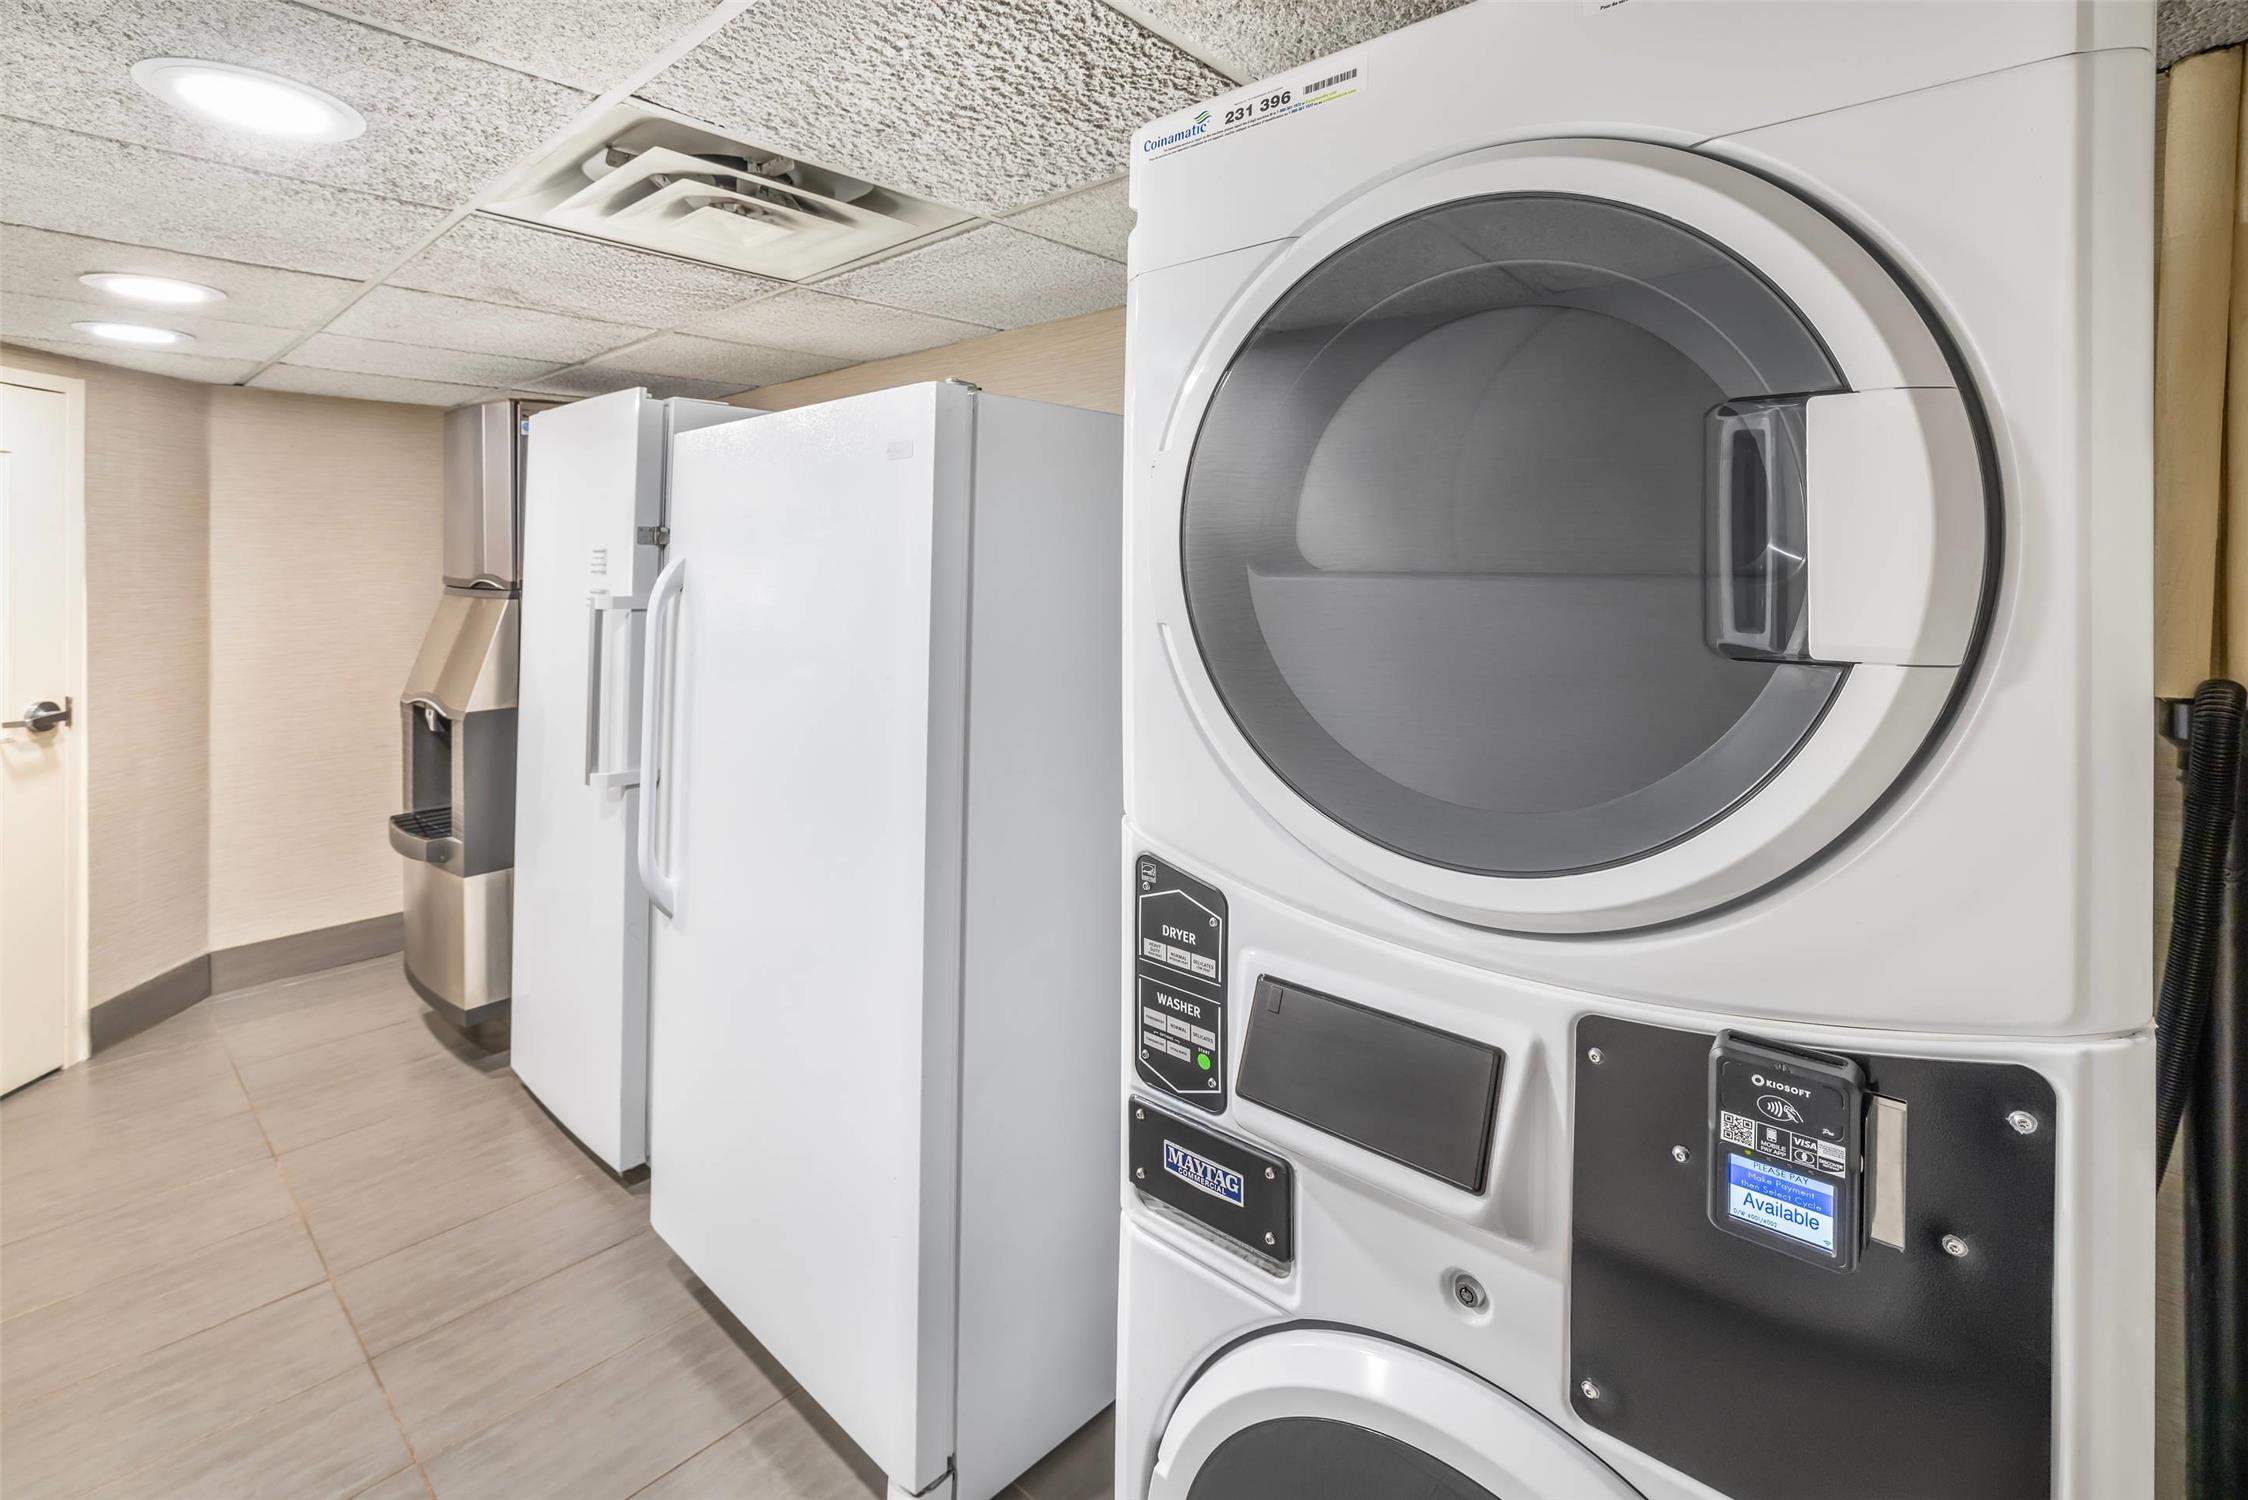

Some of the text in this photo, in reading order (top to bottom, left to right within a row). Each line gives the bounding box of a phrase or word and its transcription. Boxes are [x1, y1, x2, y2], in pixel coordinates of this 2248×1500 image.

[1225, 104, 1253, 125] 231
[1259, 91, 1291, 112] 396
[1144, 123, 1207, 152] Coinamatic
[1162, 924, 1196, 945] DRYER
[1170, 952, 1187, 960] NORMAL
[1193, 959, 1214, 970] DELICATES
[1156, 991, 1201, 1018] WASHER
[1169, 1023, 1187, 1033] NORMAL
[1192, 1031, 1214, 1044] DELICATES
[1766, 1079, 1811, 1098] KIOSOFT
[1760, 1140, 1787, 1153] MOBILE
[1760, 1146, 1787, 1157] PAY APP
[1793, 1136, 1818, 1151] VISA
[1167, 1145, 1240, 1194] MAYTAG
[1753, 1162, 1785, 1178] PLEASE
[1789, 1174, 1809, 1185] PAY
[1178, 1168, 1226, 1195] COMMERCIAL
[1748, 1171, 1815, 1199] Make Payment
[1741, 1179, 1822, 1212] then Select Cycle
[1743, 1192, 1820, 1230] Available
